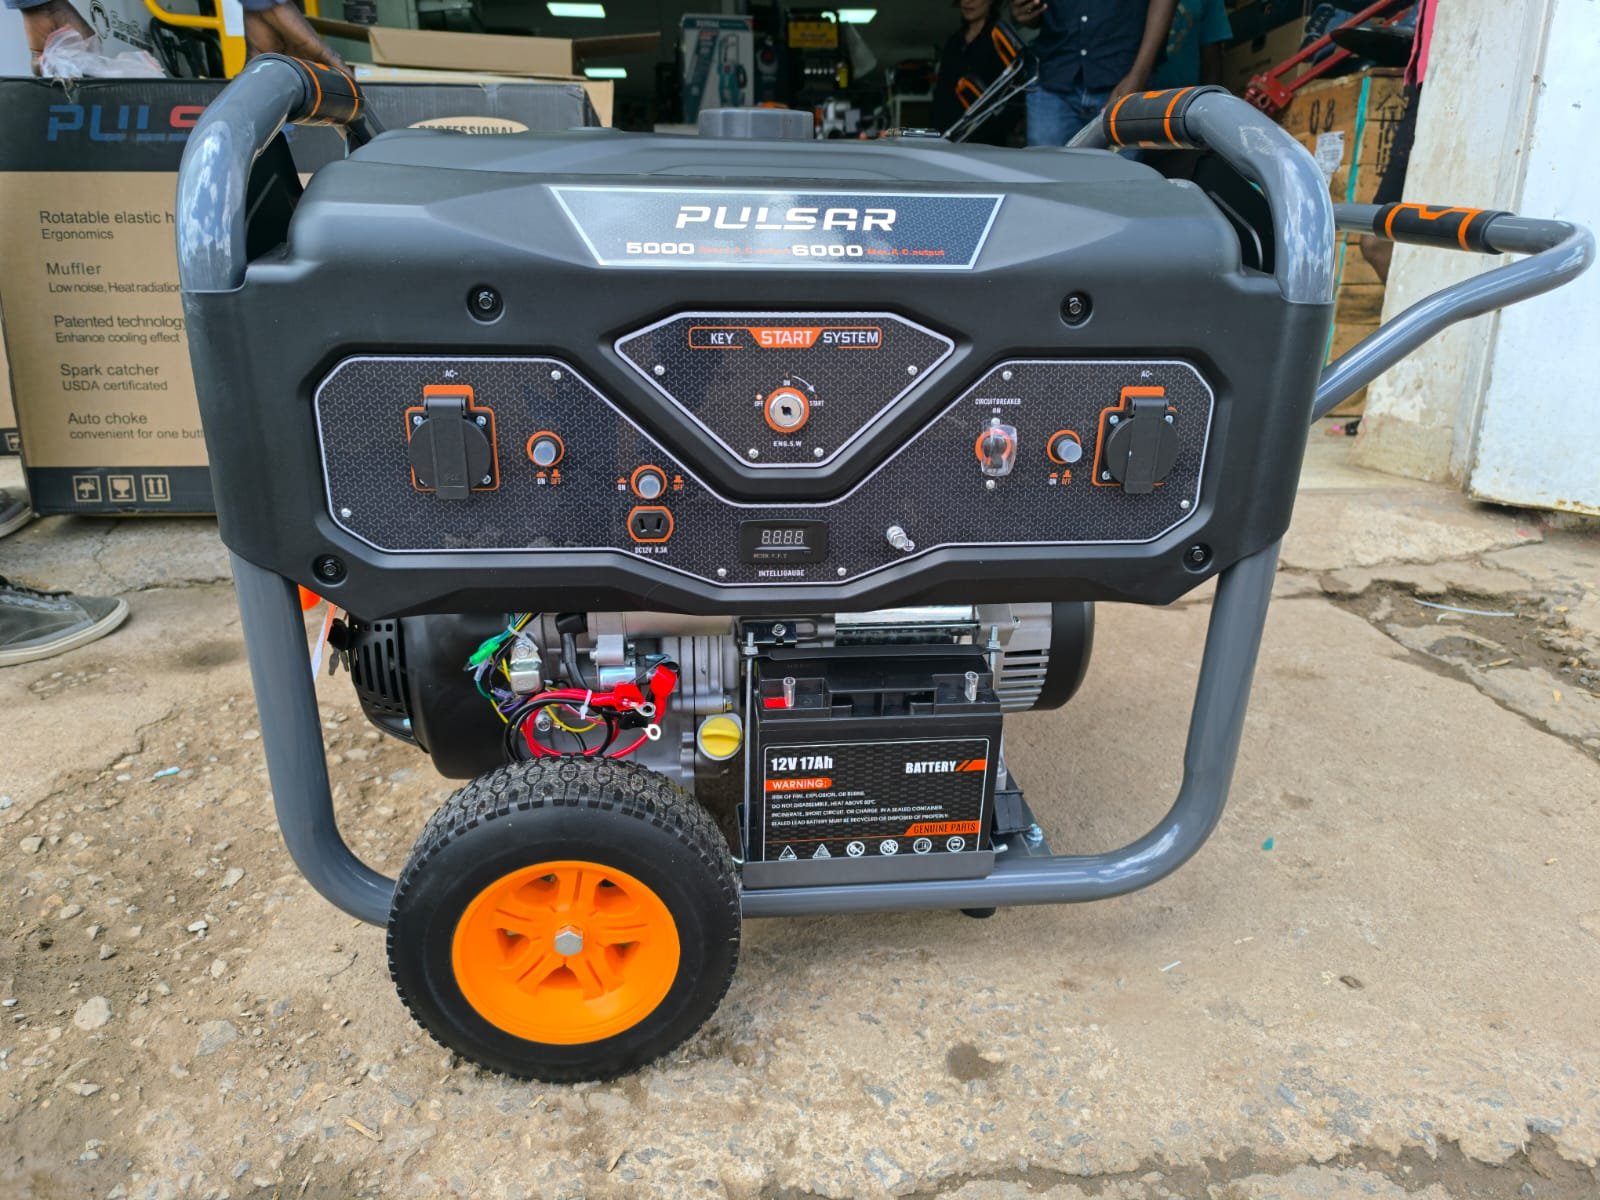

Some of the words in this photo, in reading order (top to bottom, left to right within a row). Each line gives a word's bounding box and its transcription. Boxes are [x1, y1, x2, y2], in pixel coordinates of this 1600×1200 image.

[39, 210, 110, 224] Rotatable
[114, 210, 161, 224] elastic
[675, 205, 897, 232] PULSAR
[41, 228, 114, 242] Ergonomics
[626, 242, 695, 255] 5000
[791, 244, 863, 257] 6000
[46, 262, 102, 275] Muffler
[54, 315, 114, 328] Patented
[56, 332, 105, 343] Enhance
[108, 332, 147, 345] cooling
[150, 332, 180, 343] effect
[710, 332, 735, 345] KEY
[760, 330, 813, 345] START
[823, 331, 879, 344] SYSTEM
[60, 364, 103, 377] Spark
[107, 363, 160, 376] catcher
[62, 380, 99, 391] USDA
[103, 380, 168, 391] certificated
[68, 412, 100, 425] Auto
[105, 412, 148, 425] choke
[70, 429, 135, 439] convenient
[137, 428, 153, 439] for
[157, 430, 178, 439] one
[771, 756, 798, 772] 12V
[800, 755, 834, 770] 17Ah
[905, 760, 957, 774] BATTERY
[772, 779, 829, 790] WARNING:
[913, 823, 948, 834] GENUINE
[950, 822, 976, 832] PARTS
